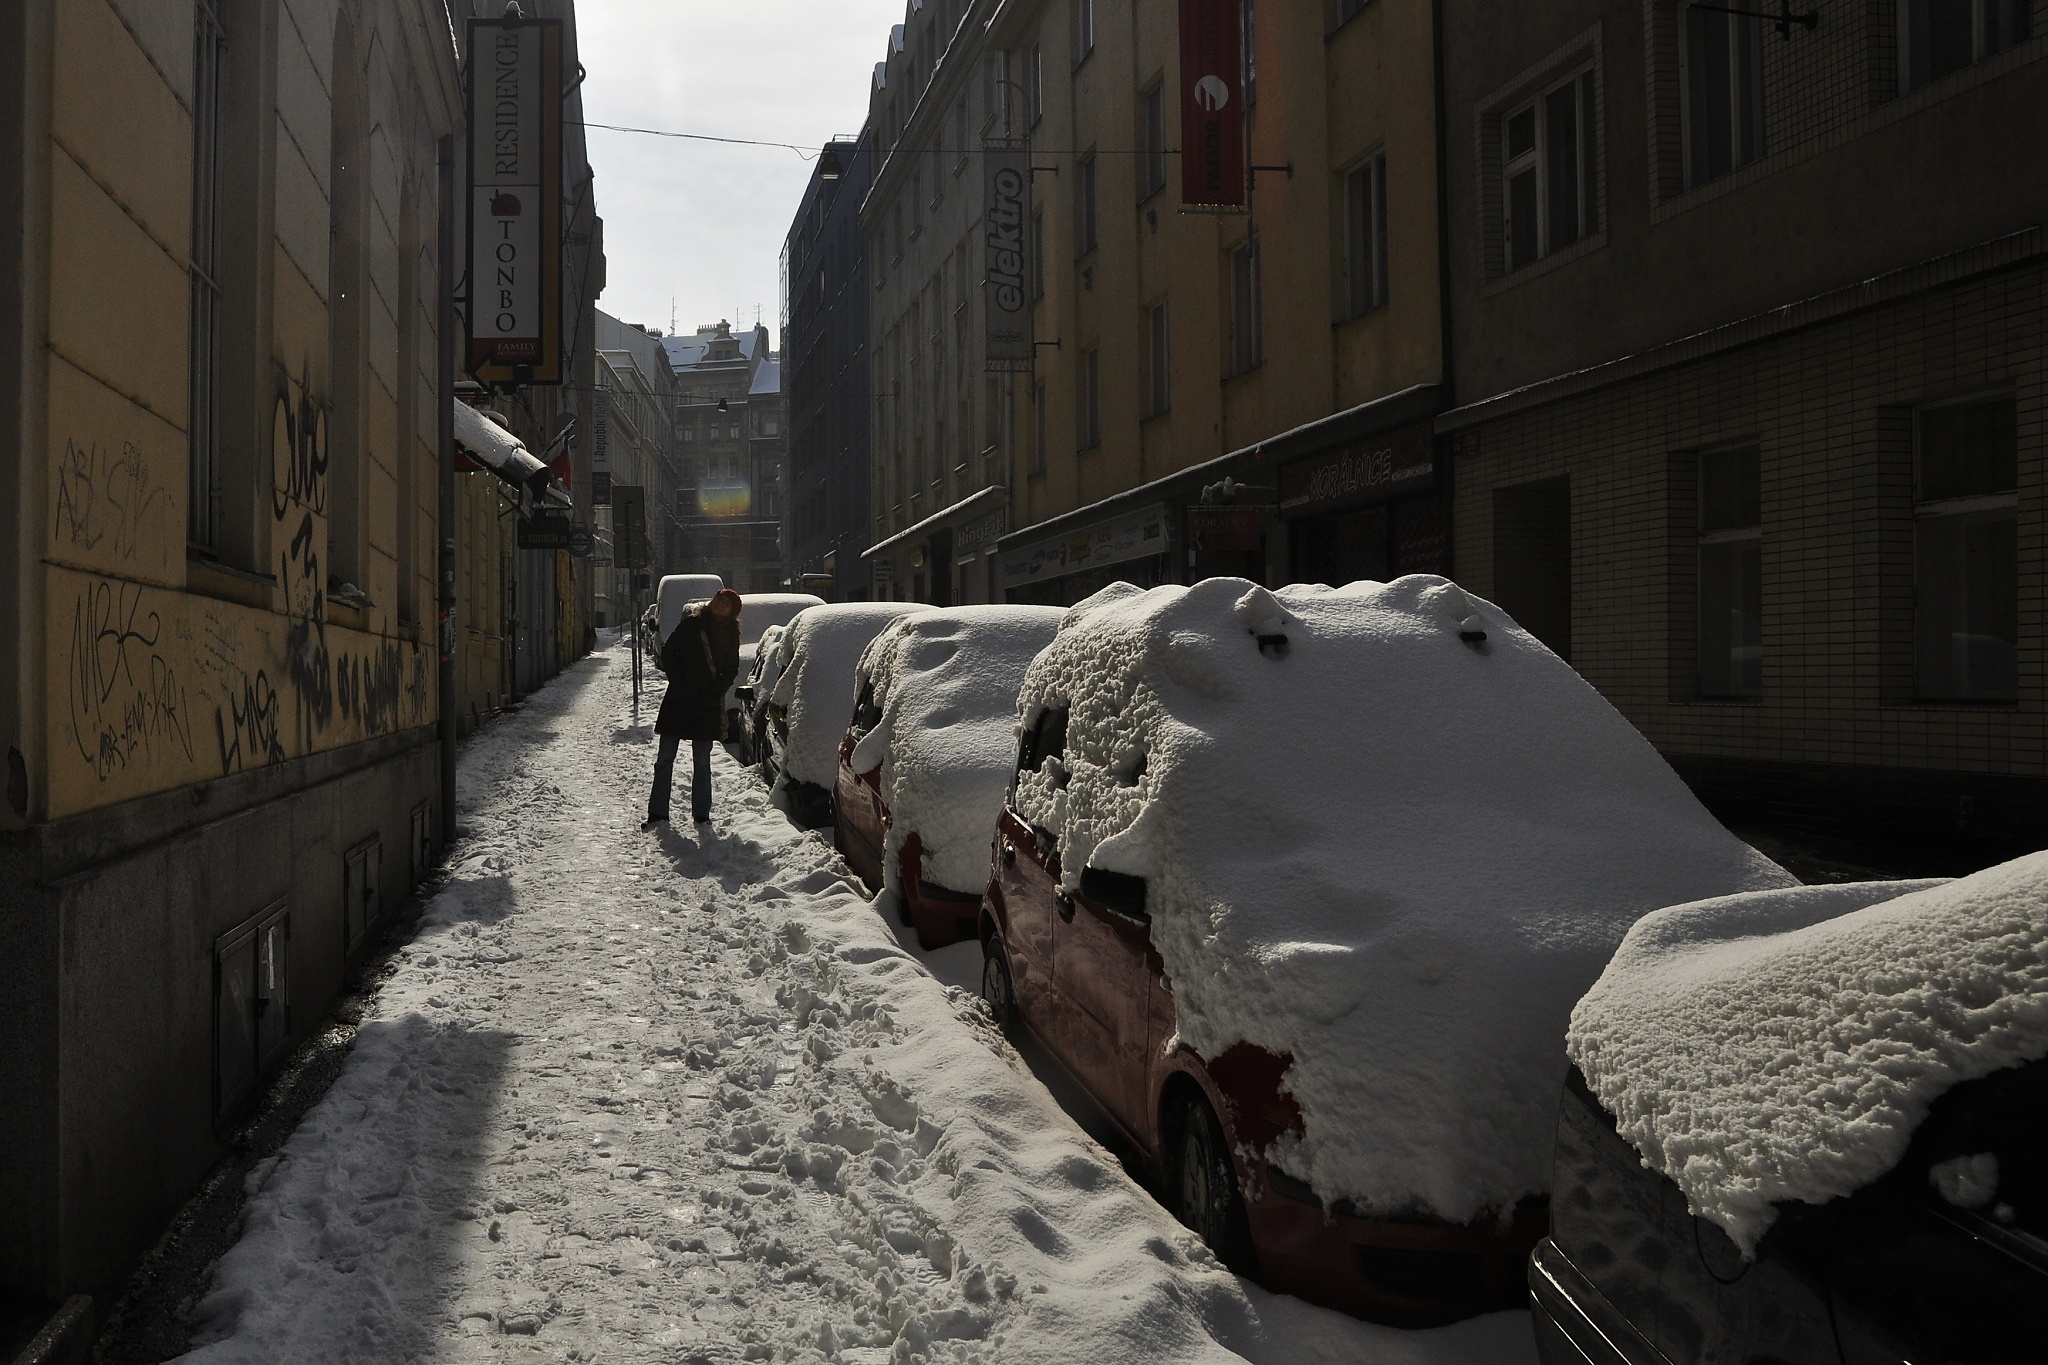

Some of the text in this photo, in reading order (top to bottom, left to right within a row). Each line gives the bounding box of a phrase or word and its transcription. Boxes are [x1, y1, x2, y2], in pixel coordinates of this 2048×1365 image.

[495, 34, 518, 176] RESIDENCE
[1205, 121, 1220, 191] FAGOR
[495, 220, 516, 332] TONBO
[988, 168, 1024, 313] elektro
[497, 343, 537, 351] FAMILY
[1310, 448, 1392, 501] KORÁLNICE
